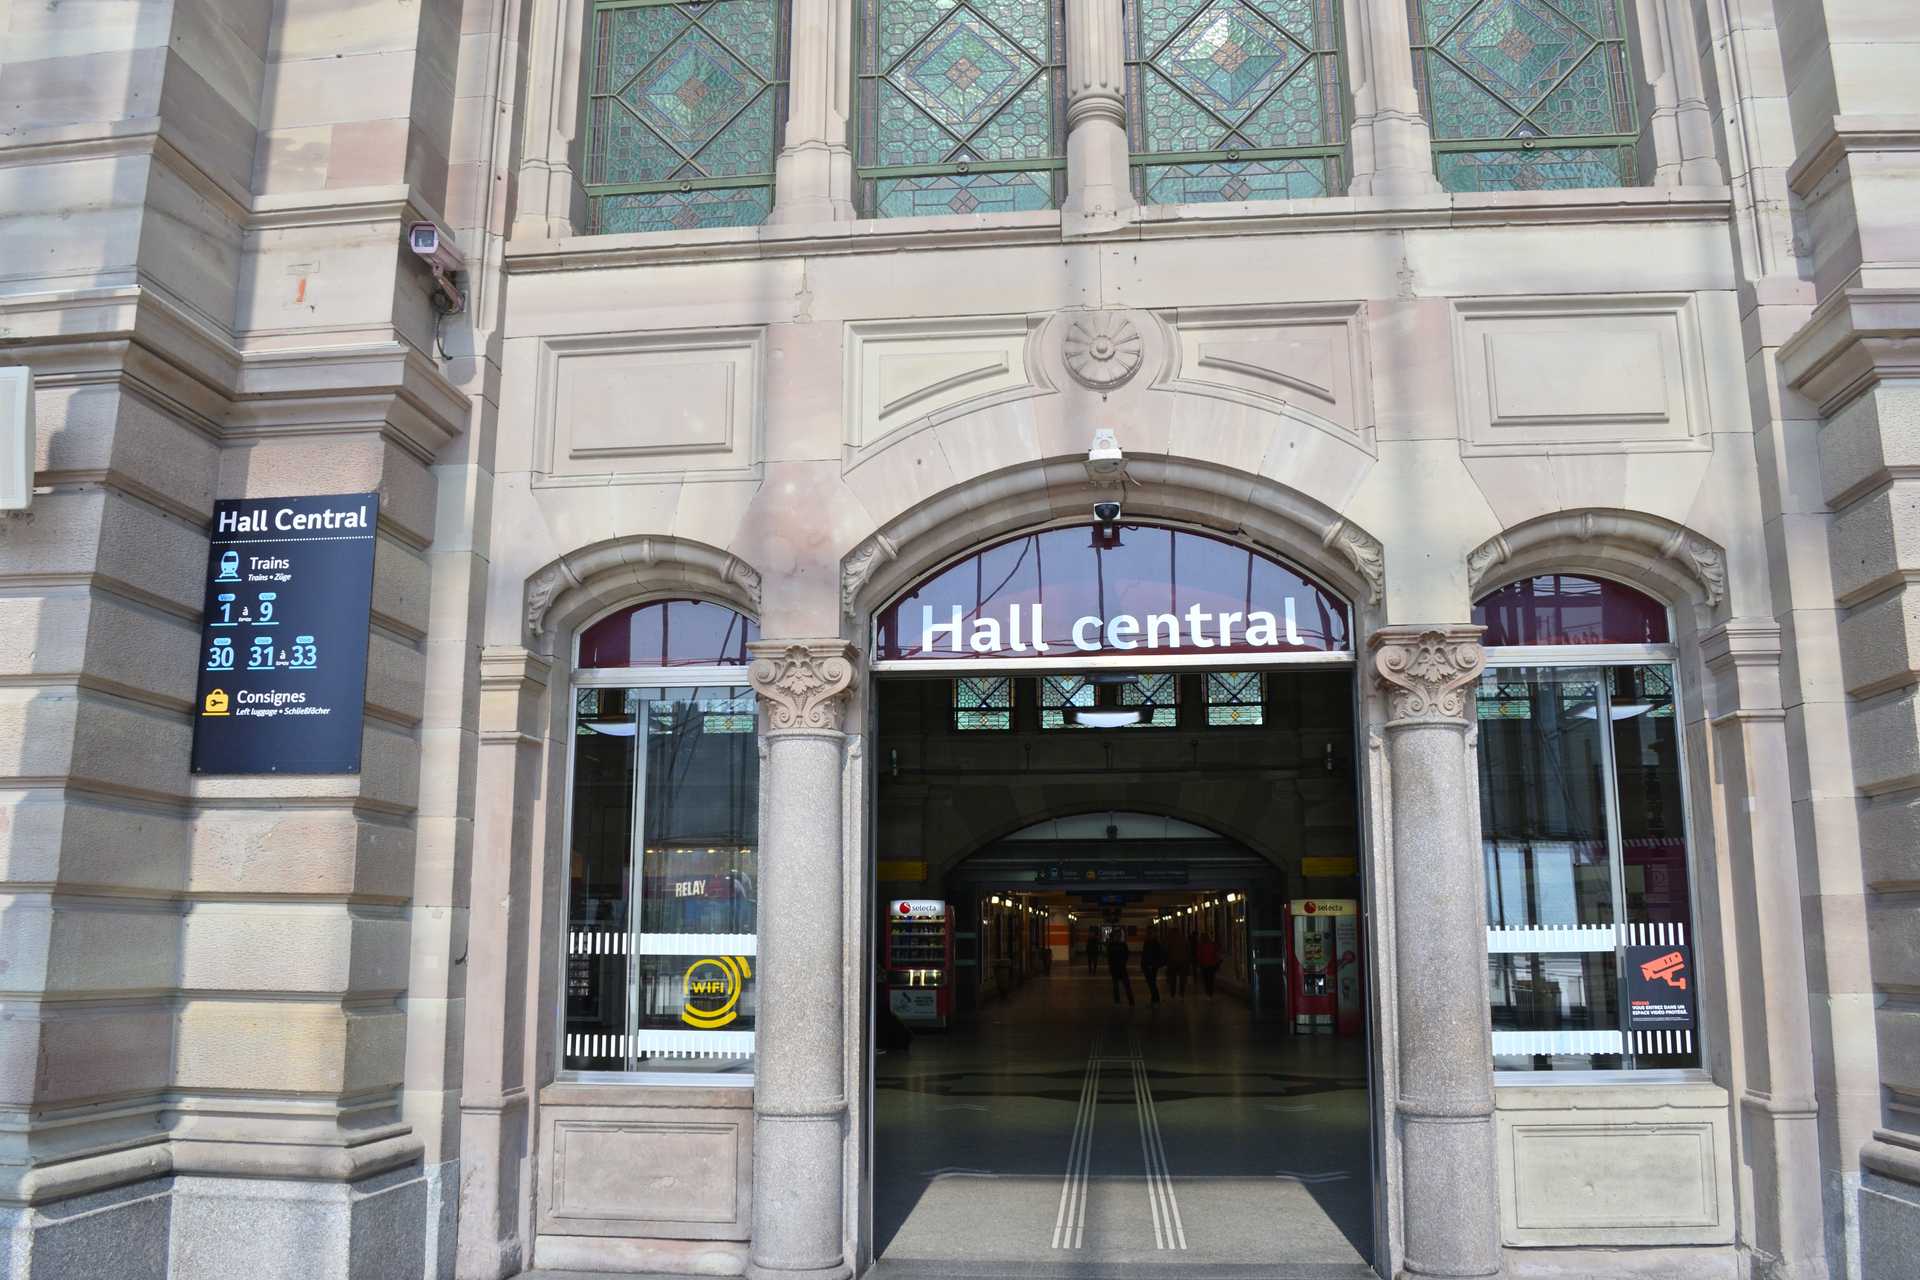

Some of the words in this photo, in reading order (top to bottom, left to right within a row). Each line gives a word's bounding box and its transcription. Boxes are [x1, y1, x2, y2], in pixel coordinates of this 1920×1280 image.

[218, 509, 269, 533] Hall
[275, 505, 368, 531] Central
[249, 556, 290, 570] Trains
[248, 573, 269, 582] Trains
[220, 602, 231, 622] 1
[259, 601, 273, 622] 9
[921, 603, 1050, 652] Hall
[1071, 597, 1305, 650] central
[207, 646, 235, 667] 30
[248, 646, 274, 667] 31
[290, 644, 317, 666] 33
[236, 689, 307, 706] Consignes
[235, 708, 251, 716] Left
[250, 707, 278, 717] luggage
[675, 879, 706, 897] RELAY
[911, 904, 937, 912] selecta
[1317, 904, 1343, 912] selecta
[691, 981, 725, 993] WIFI
